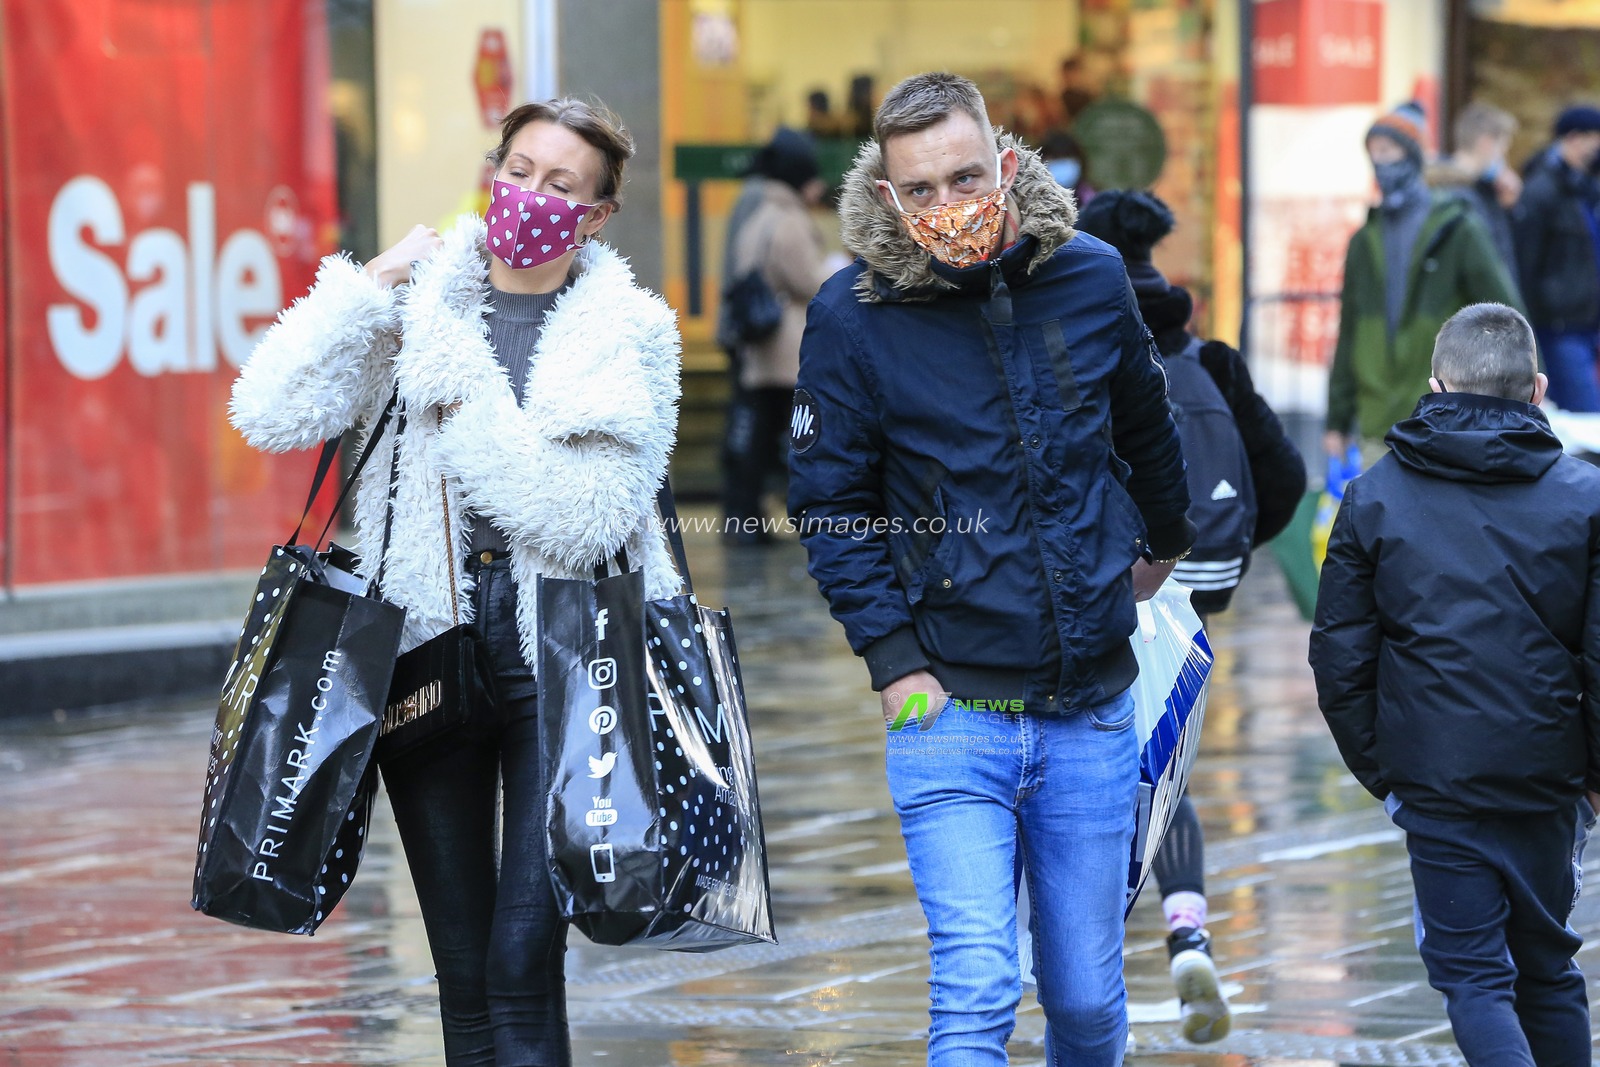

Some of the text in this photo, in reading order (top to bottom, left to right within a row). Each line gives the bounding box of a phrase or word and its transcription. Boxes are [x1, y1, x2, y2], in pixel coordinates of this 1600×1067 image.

[47, 175, 282, 380] Sale
[252, 649, 342, 882] PRIMARK.com
[590, 811, 613, 823] Tube
[592, 795, 612, 809] You
